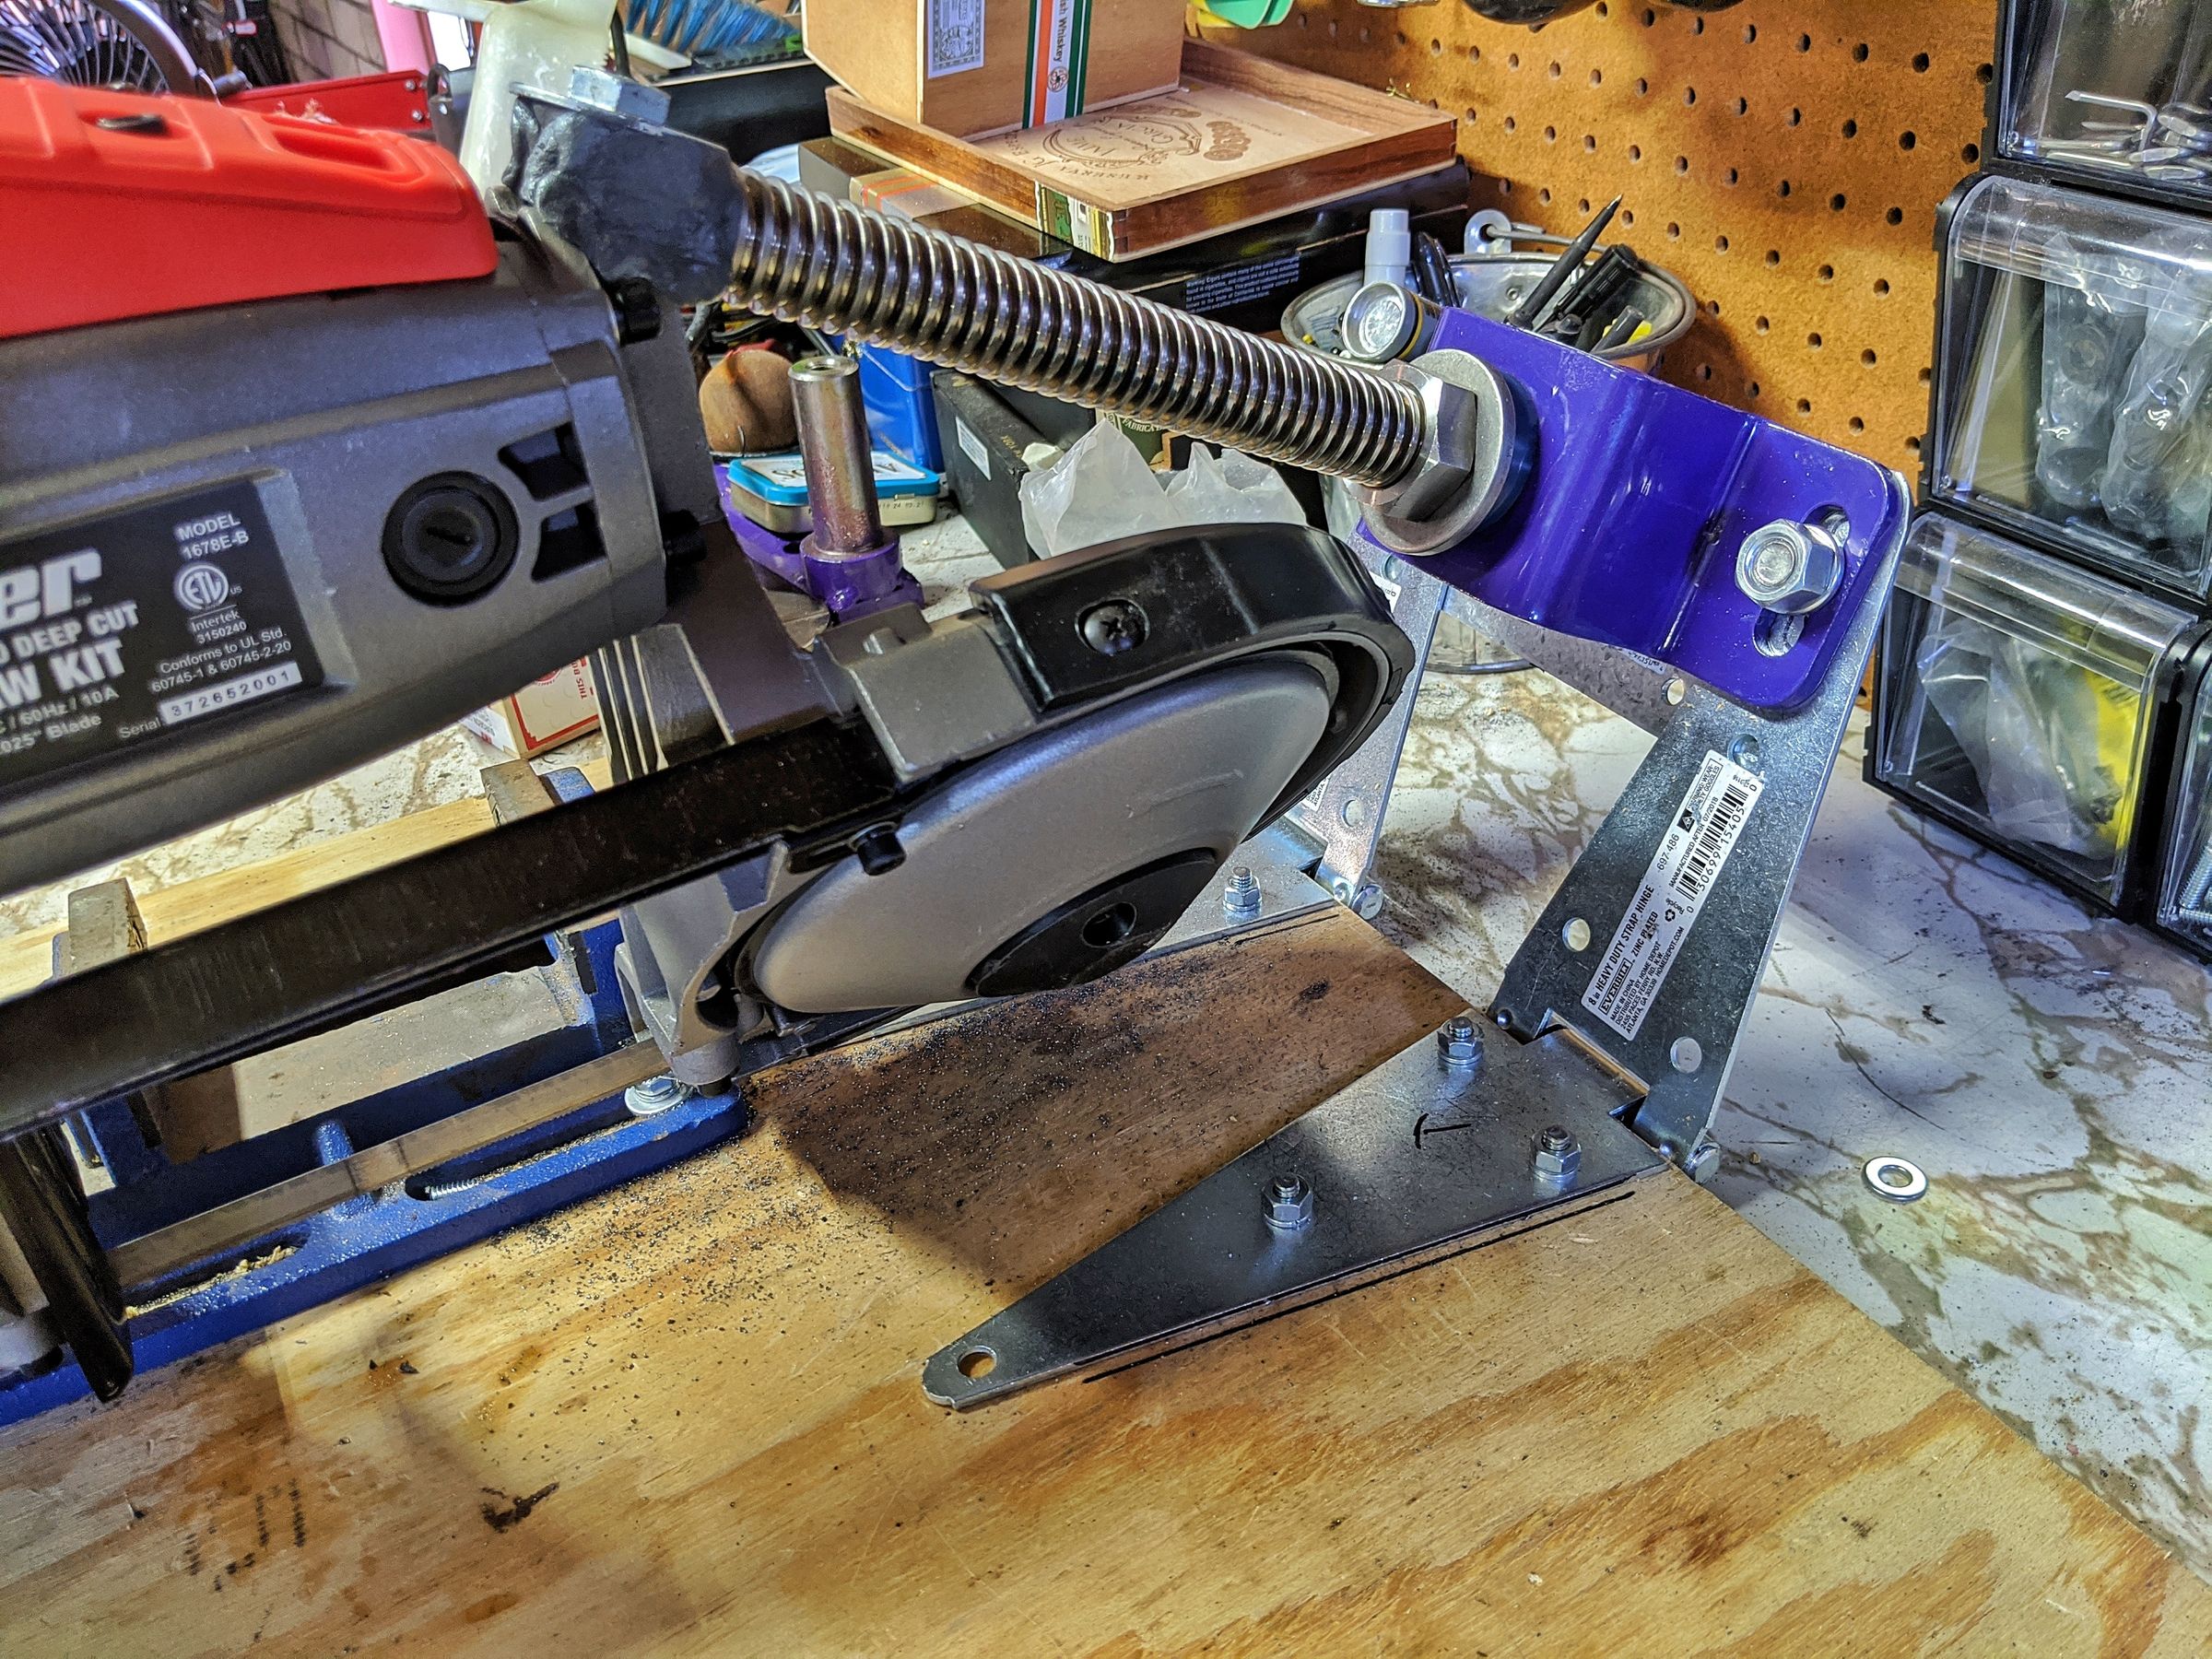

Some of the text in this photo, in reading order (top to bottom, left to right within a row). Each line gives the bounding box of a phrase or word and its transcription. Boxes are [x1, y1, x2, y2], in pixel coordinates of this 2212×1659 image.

[1053, 17, 1067, 62] Whiskey
[1123, 418, 1154, 432] FABRICA
[178, 514, 241, 540] MODEL
[182, 531, 249, 559] 1678E-B
[12, 619, 82, 659] DEEP
[87, 601, 139, 637] CUT
[191, 610, 241, 633] Intertek
[196, 621, 247, 644] 3150240
[151, 641, 292, 692] 60745-1 & 60745-2-20
[160, 627, 288, 674] Conforms to UL Std.
[0, 663, 41, 711] W
[49, 637, 125, 692] KIT
[576, 678, 587, 700] THIS
[19, 703, 68, 725] 60Hz
[80, 686, 120, 707] 10A
[46, 715, 101, 739] Blade
[118, 717, 161, 738] Serial
[1668, 796, 1718, 888] MANUFACTURED AFTER 07/2018
[1588, 997, 1596, 1006] 8
[1595, 963, 1613, 992] HEAVY
[1609, 940, 1625, 964] DUTY
[1621, 912, 1638, 941] STRAP
[1635, 885, 1654, 913] HINGE
[1631, 938, 1644, 957] ZINC
[1640, 997, 1648, 1006] GA
[1655, 926, 1684, 977] HOMEDEPOT.COM
[1610, 1004, 1621, 1020] MADE
[1622, 979, 1635, 996] CHINA
[1616, 941, 1661, 1025] DISTRIBUTED BY HOME DEPOT
[1620, 1014, 1631, 1030] 2455
[1628, 994, 1641, 1015] PACES
[1638, 975, 1650, 995] FERRY
